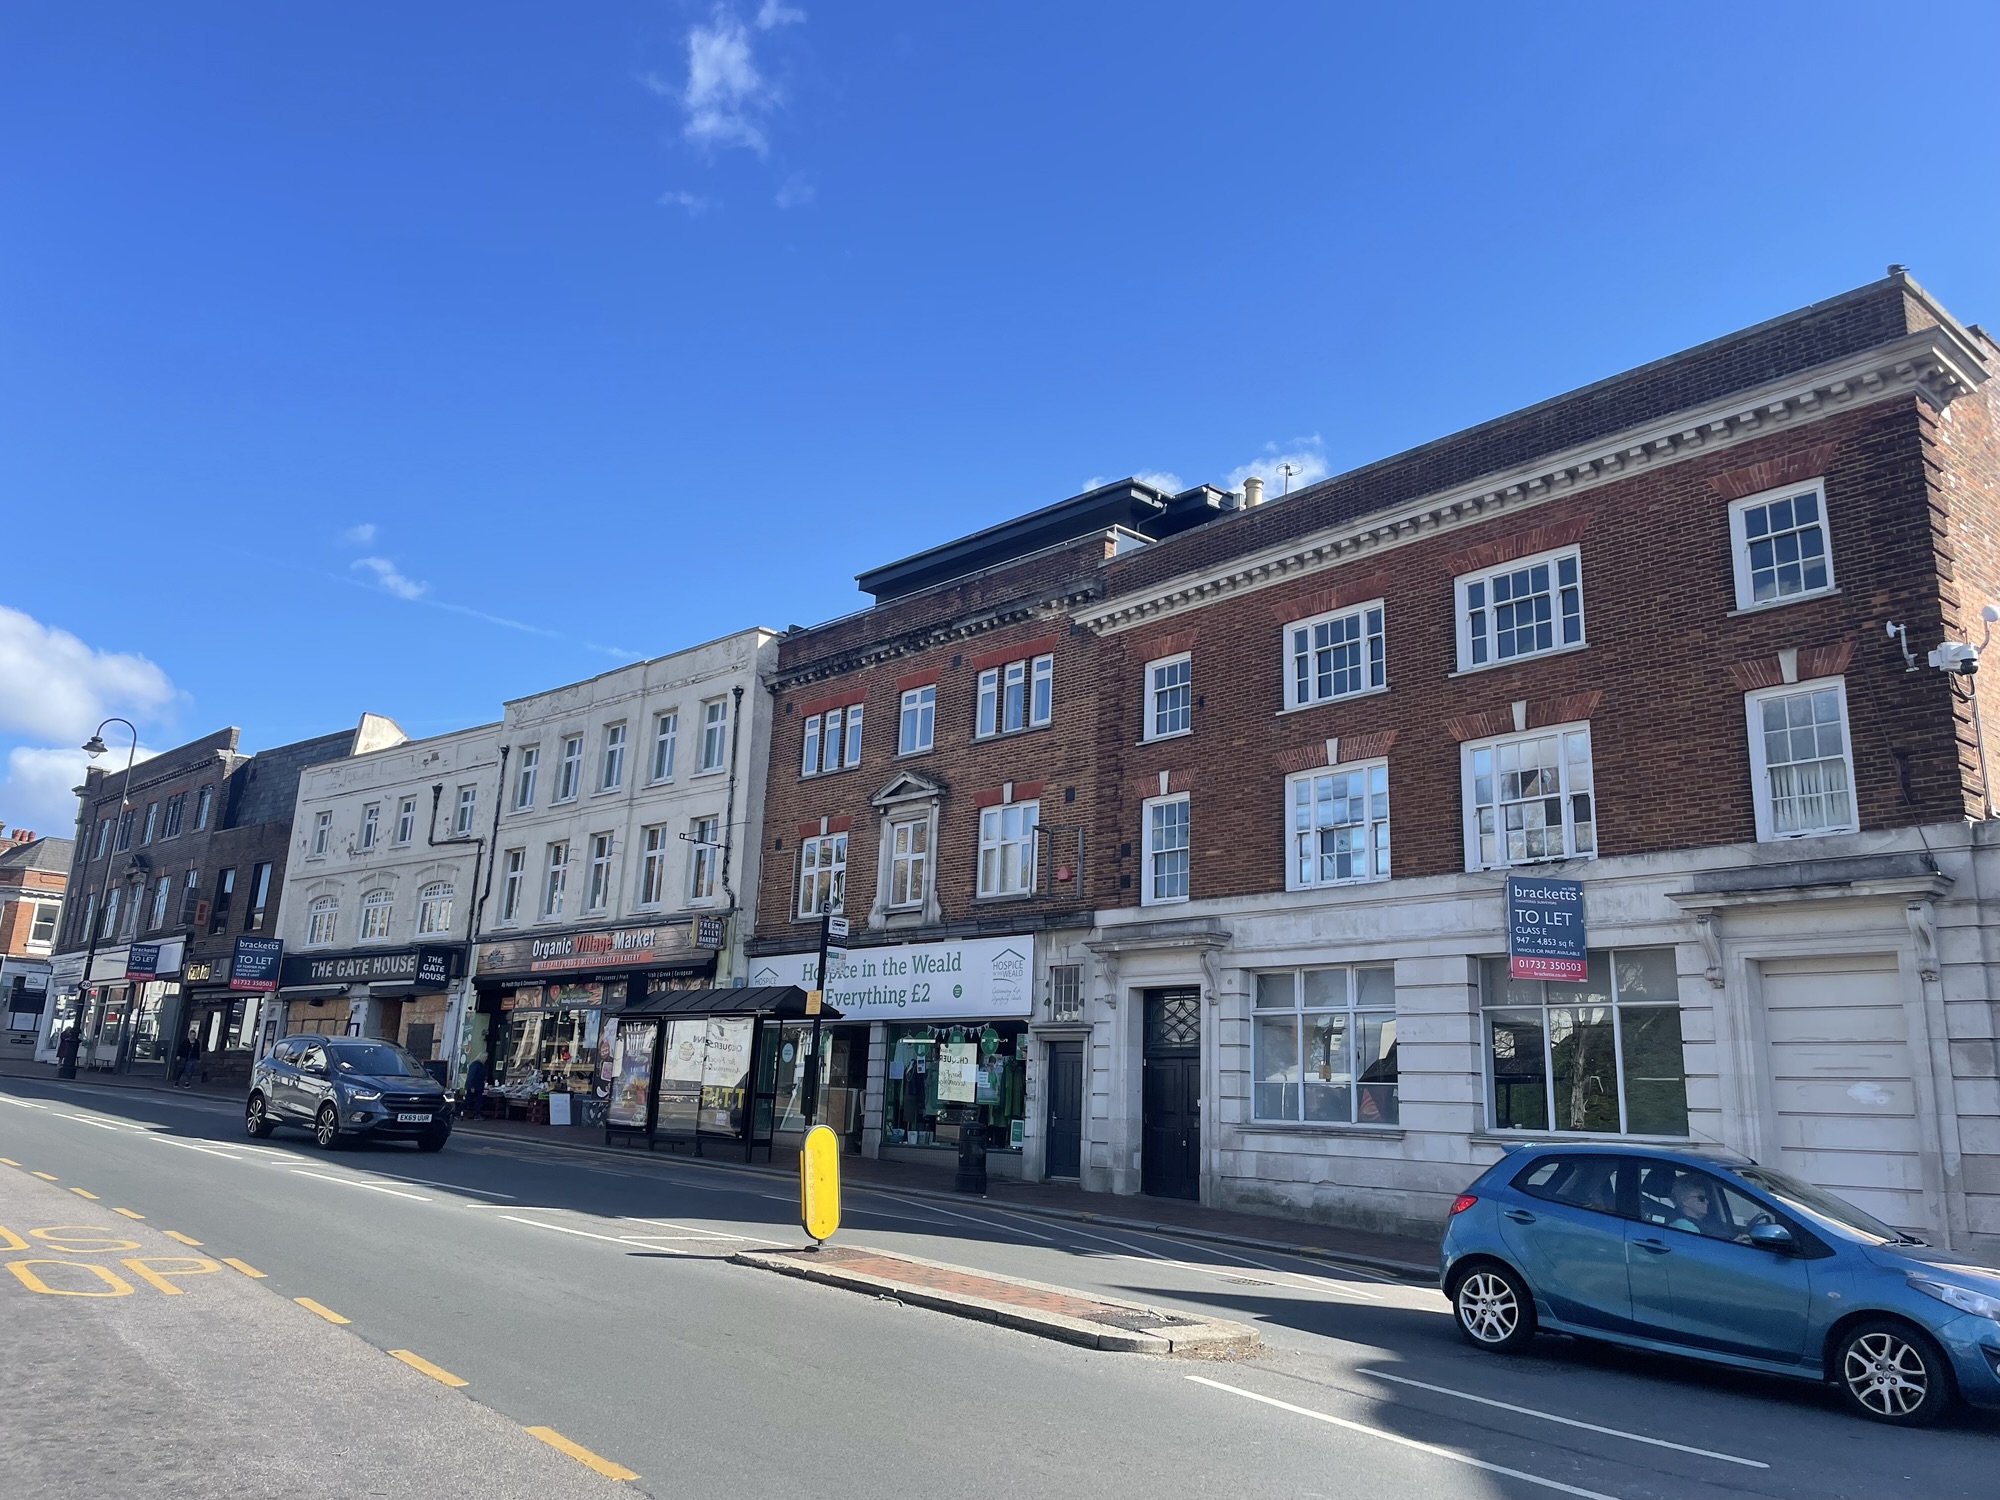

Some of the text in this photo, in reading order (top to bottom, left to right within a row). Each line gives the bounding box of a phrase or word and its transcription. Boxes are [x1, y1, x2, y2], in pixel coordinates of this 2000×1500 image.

[1514, 885, 1576, 900] bracketts
[824, 903, 829, 913] E
[1515, 909, 1572, 926] TO LET
[1516, 926, 1540, 934] CLASS
[240, 940, 279, 950] bracketts
[532, 929, 656, 960] Organic Village Market
[1537, 938, 1556, 946] 4,853
[238, 955, 273, 965] TO LET
[427, 955, 443, 964] THE
[311, 955, 416, 978] THE GATE HOUSE
[423, 964, 445, 973] GATE
[802, 963, 857, 983] Hopce
[862, 958, 875, 978] in
[882, 954, 907, 975] the
[911, 951, 962, 974] Weald
[993, 960, 1023, 970] HOSPICE
[1519, 960, 1582, 971] 01732 350503
[418, 972, 446, 982] HOUSE
[755, 977, 776, 986] HOSPICE
[826, 985, 907, 1009] Everything
[911, 982, 930, 1003] £2
